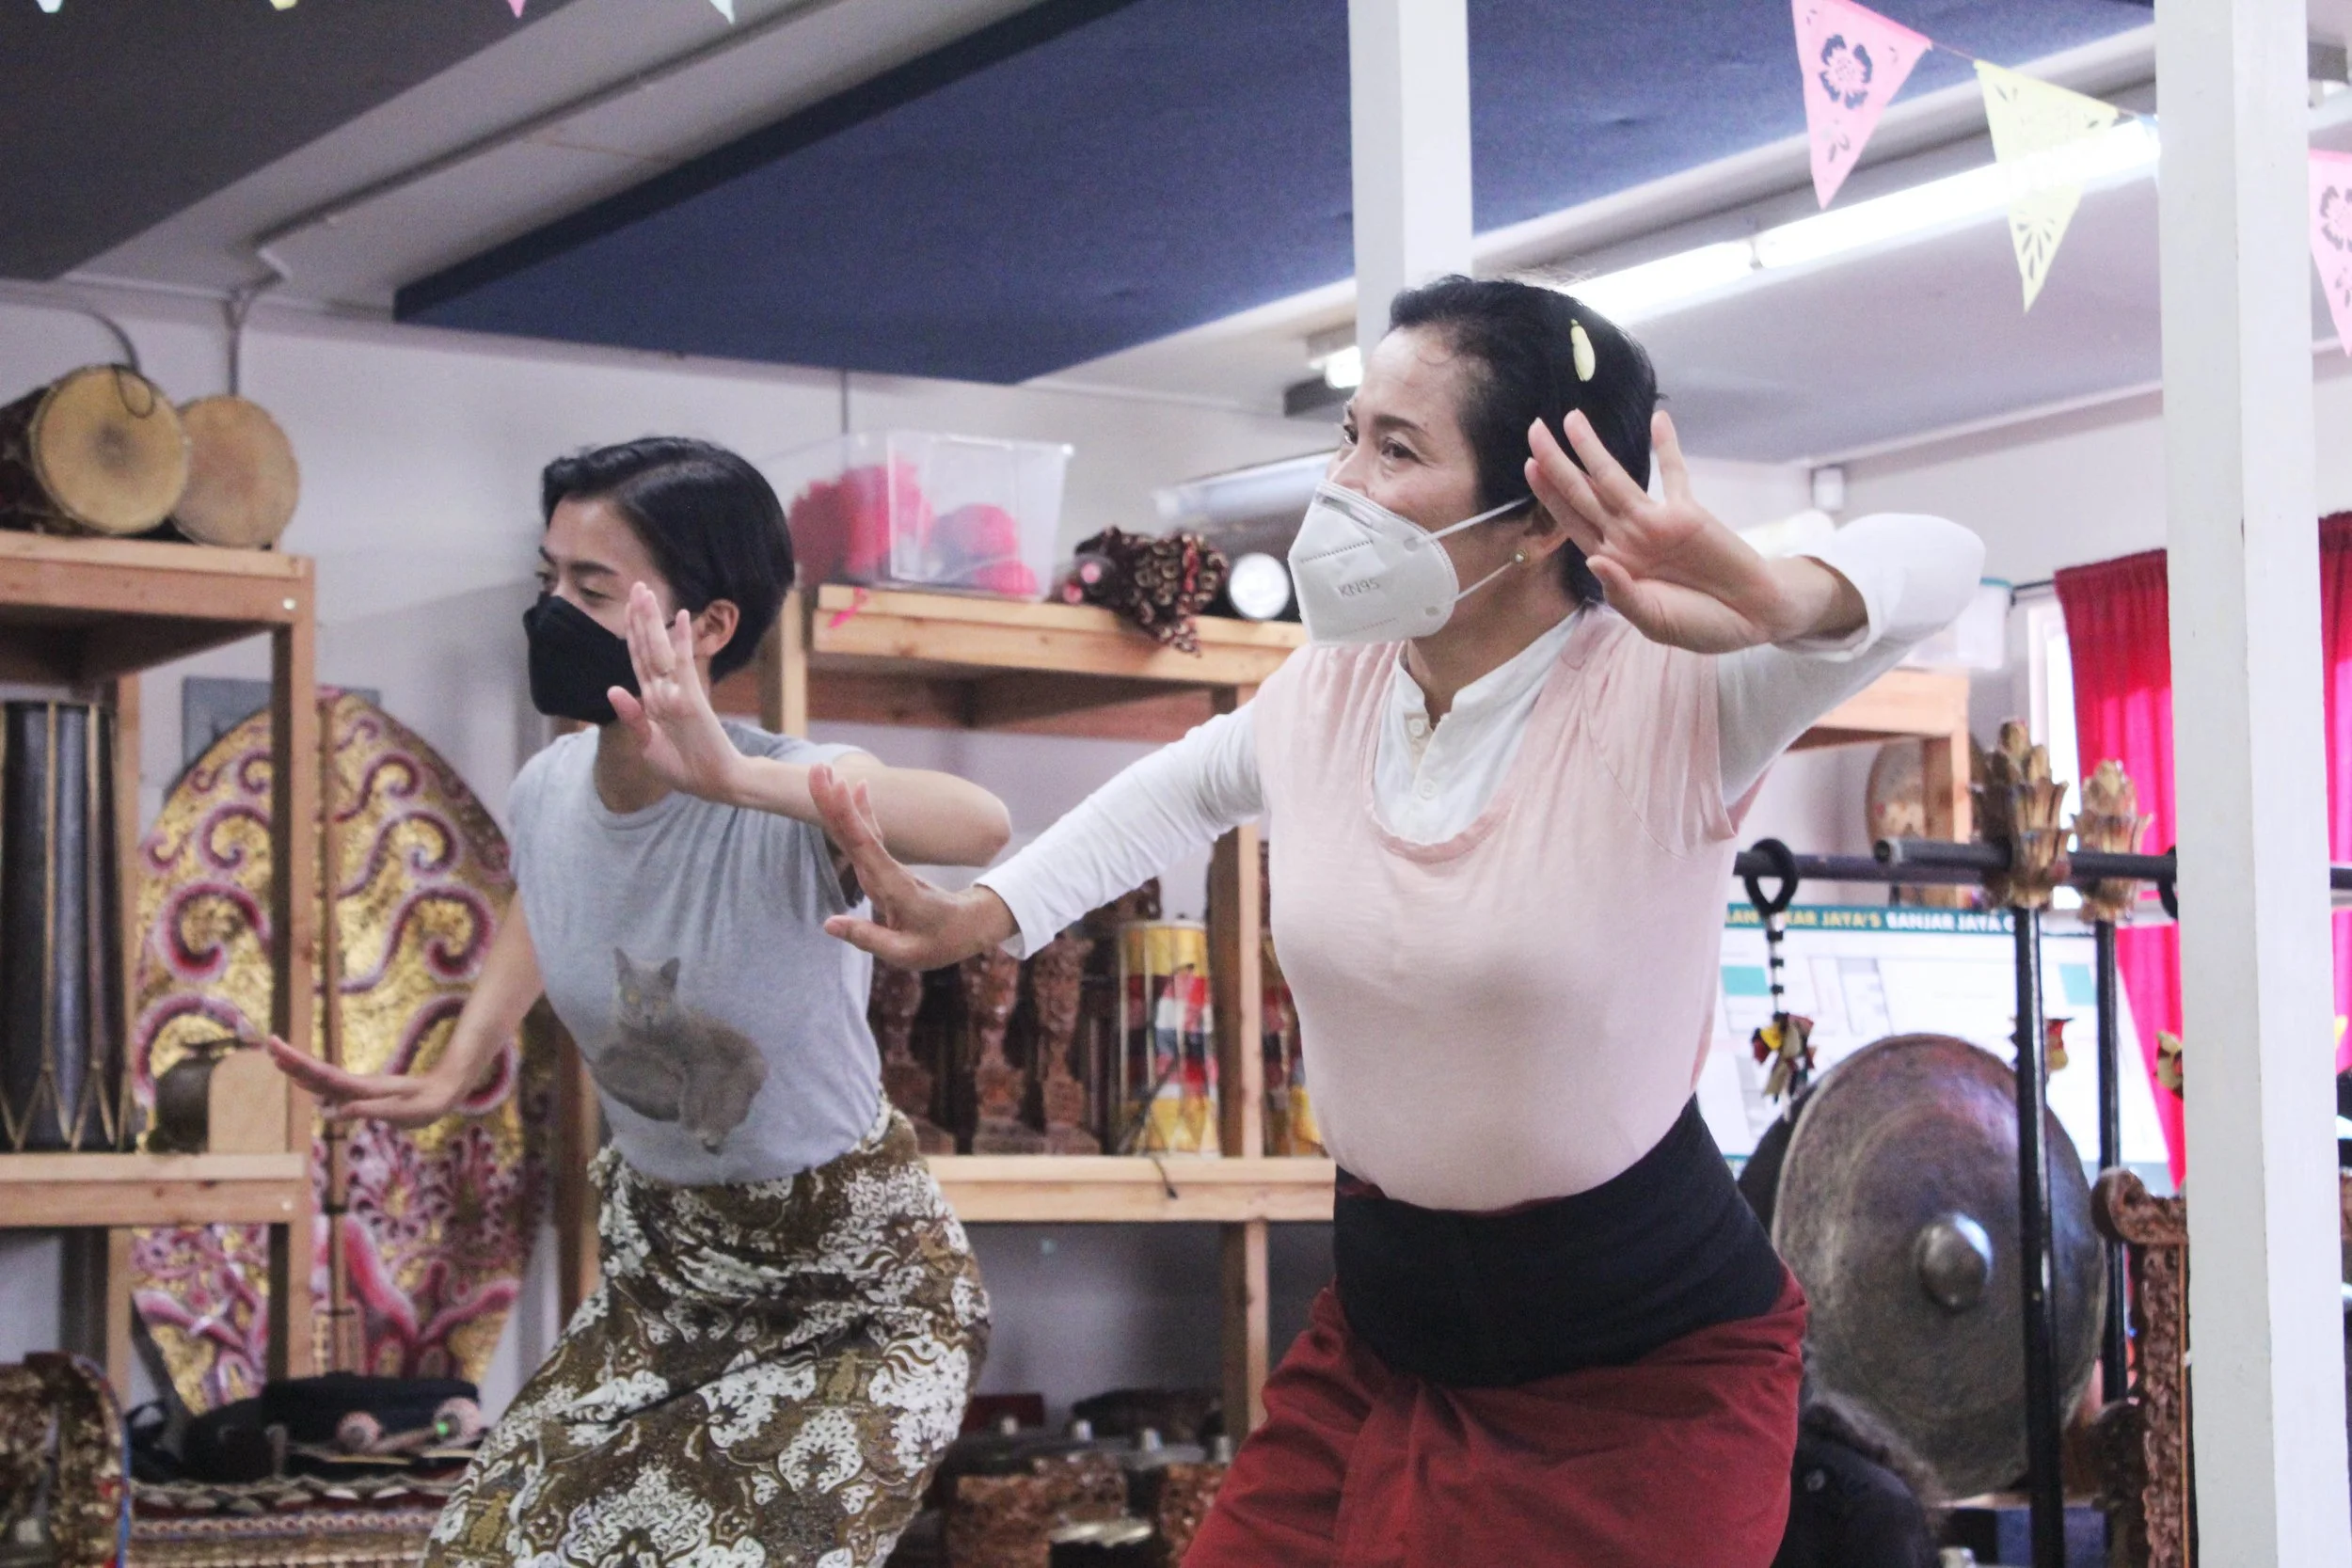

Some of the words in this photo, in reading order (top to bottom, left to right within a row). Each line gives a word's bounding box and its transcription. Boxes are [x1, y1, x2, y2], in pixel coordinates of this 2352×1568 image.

[1337, 578, 1380, 597] KN95
[1885, 911, 1955, 930] BANJAR
[1958, 913, 2003, 932] JAYA
